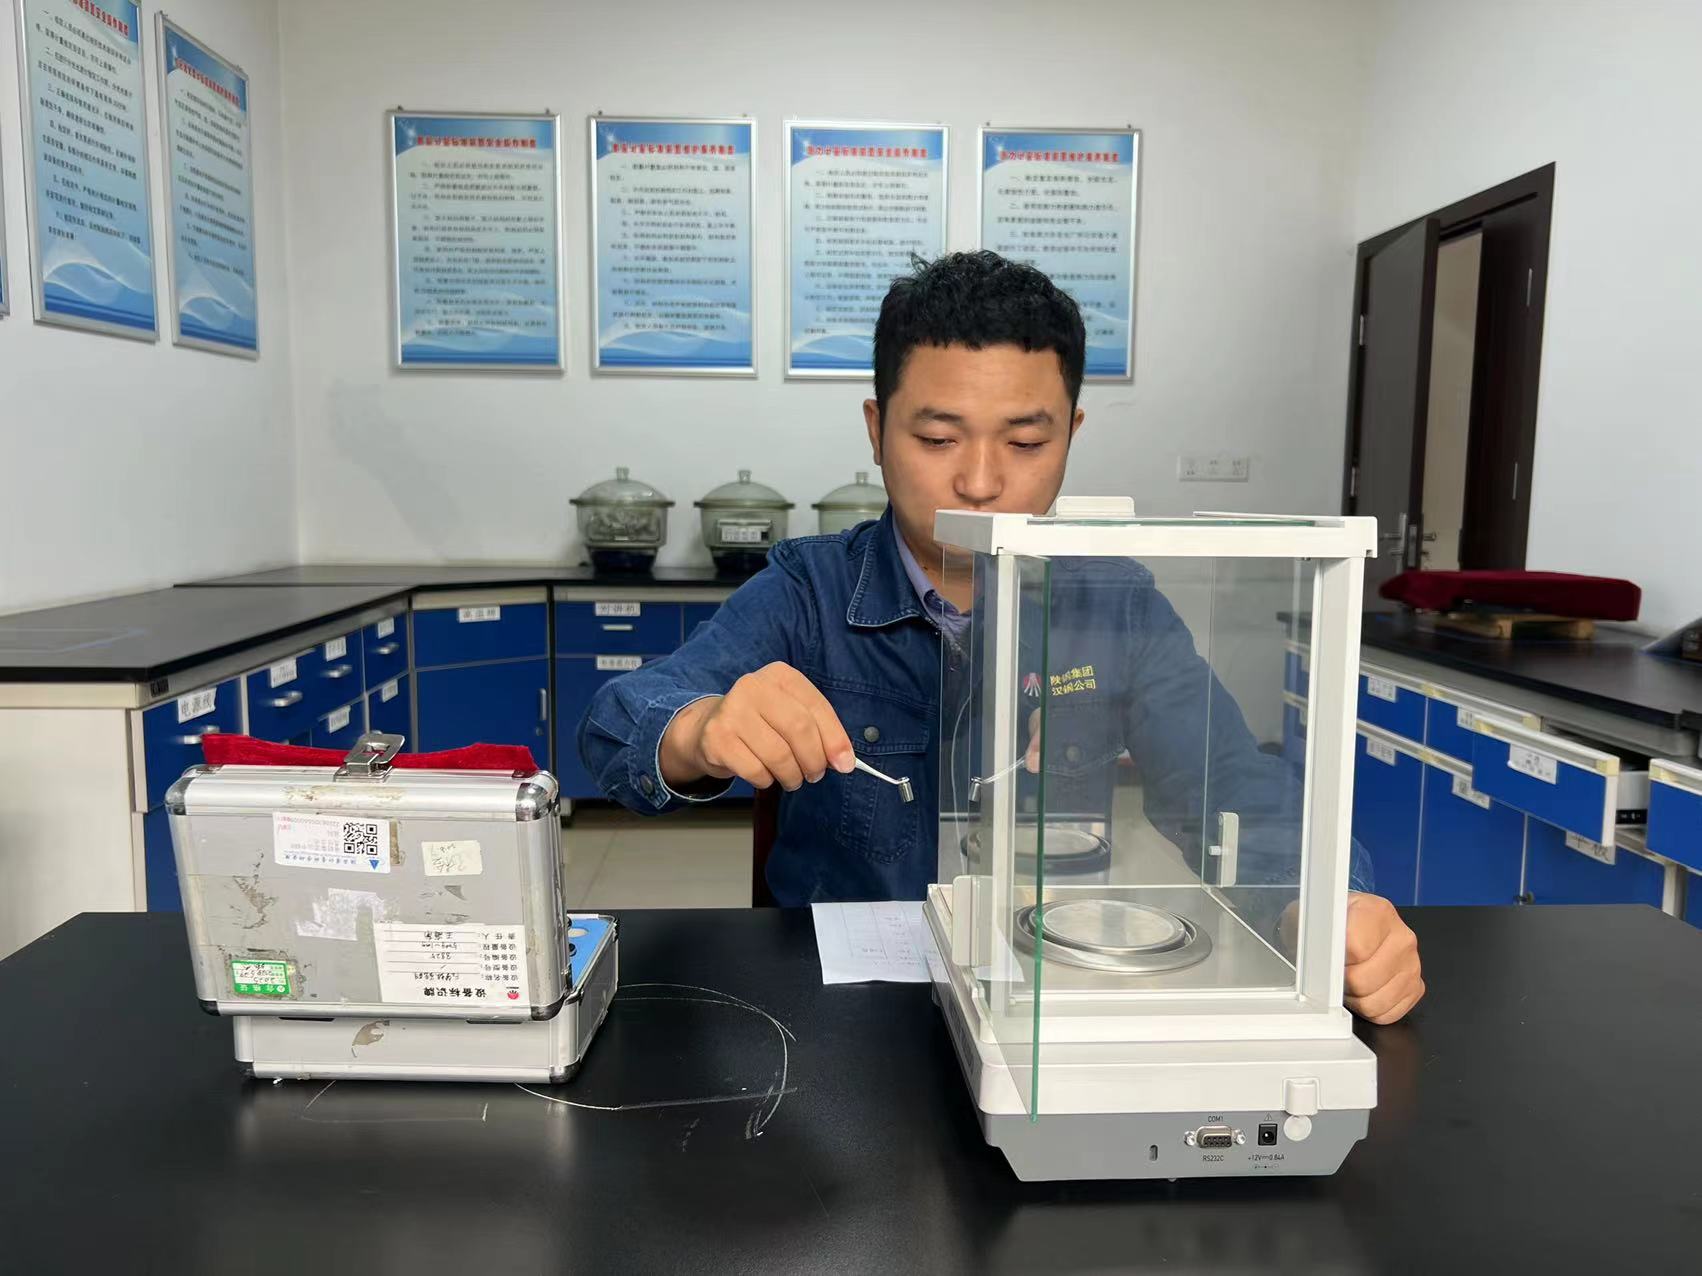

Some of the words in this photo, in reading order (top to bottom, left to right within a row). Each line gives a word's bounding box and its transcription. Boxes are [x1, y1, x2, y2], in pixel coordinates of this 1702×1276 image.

[424, 986, 487, 998] 设备标识牌
[1207, 1115, 1224, 1123] COM1
[1202, 1154, 1225, 1162] RS232C
